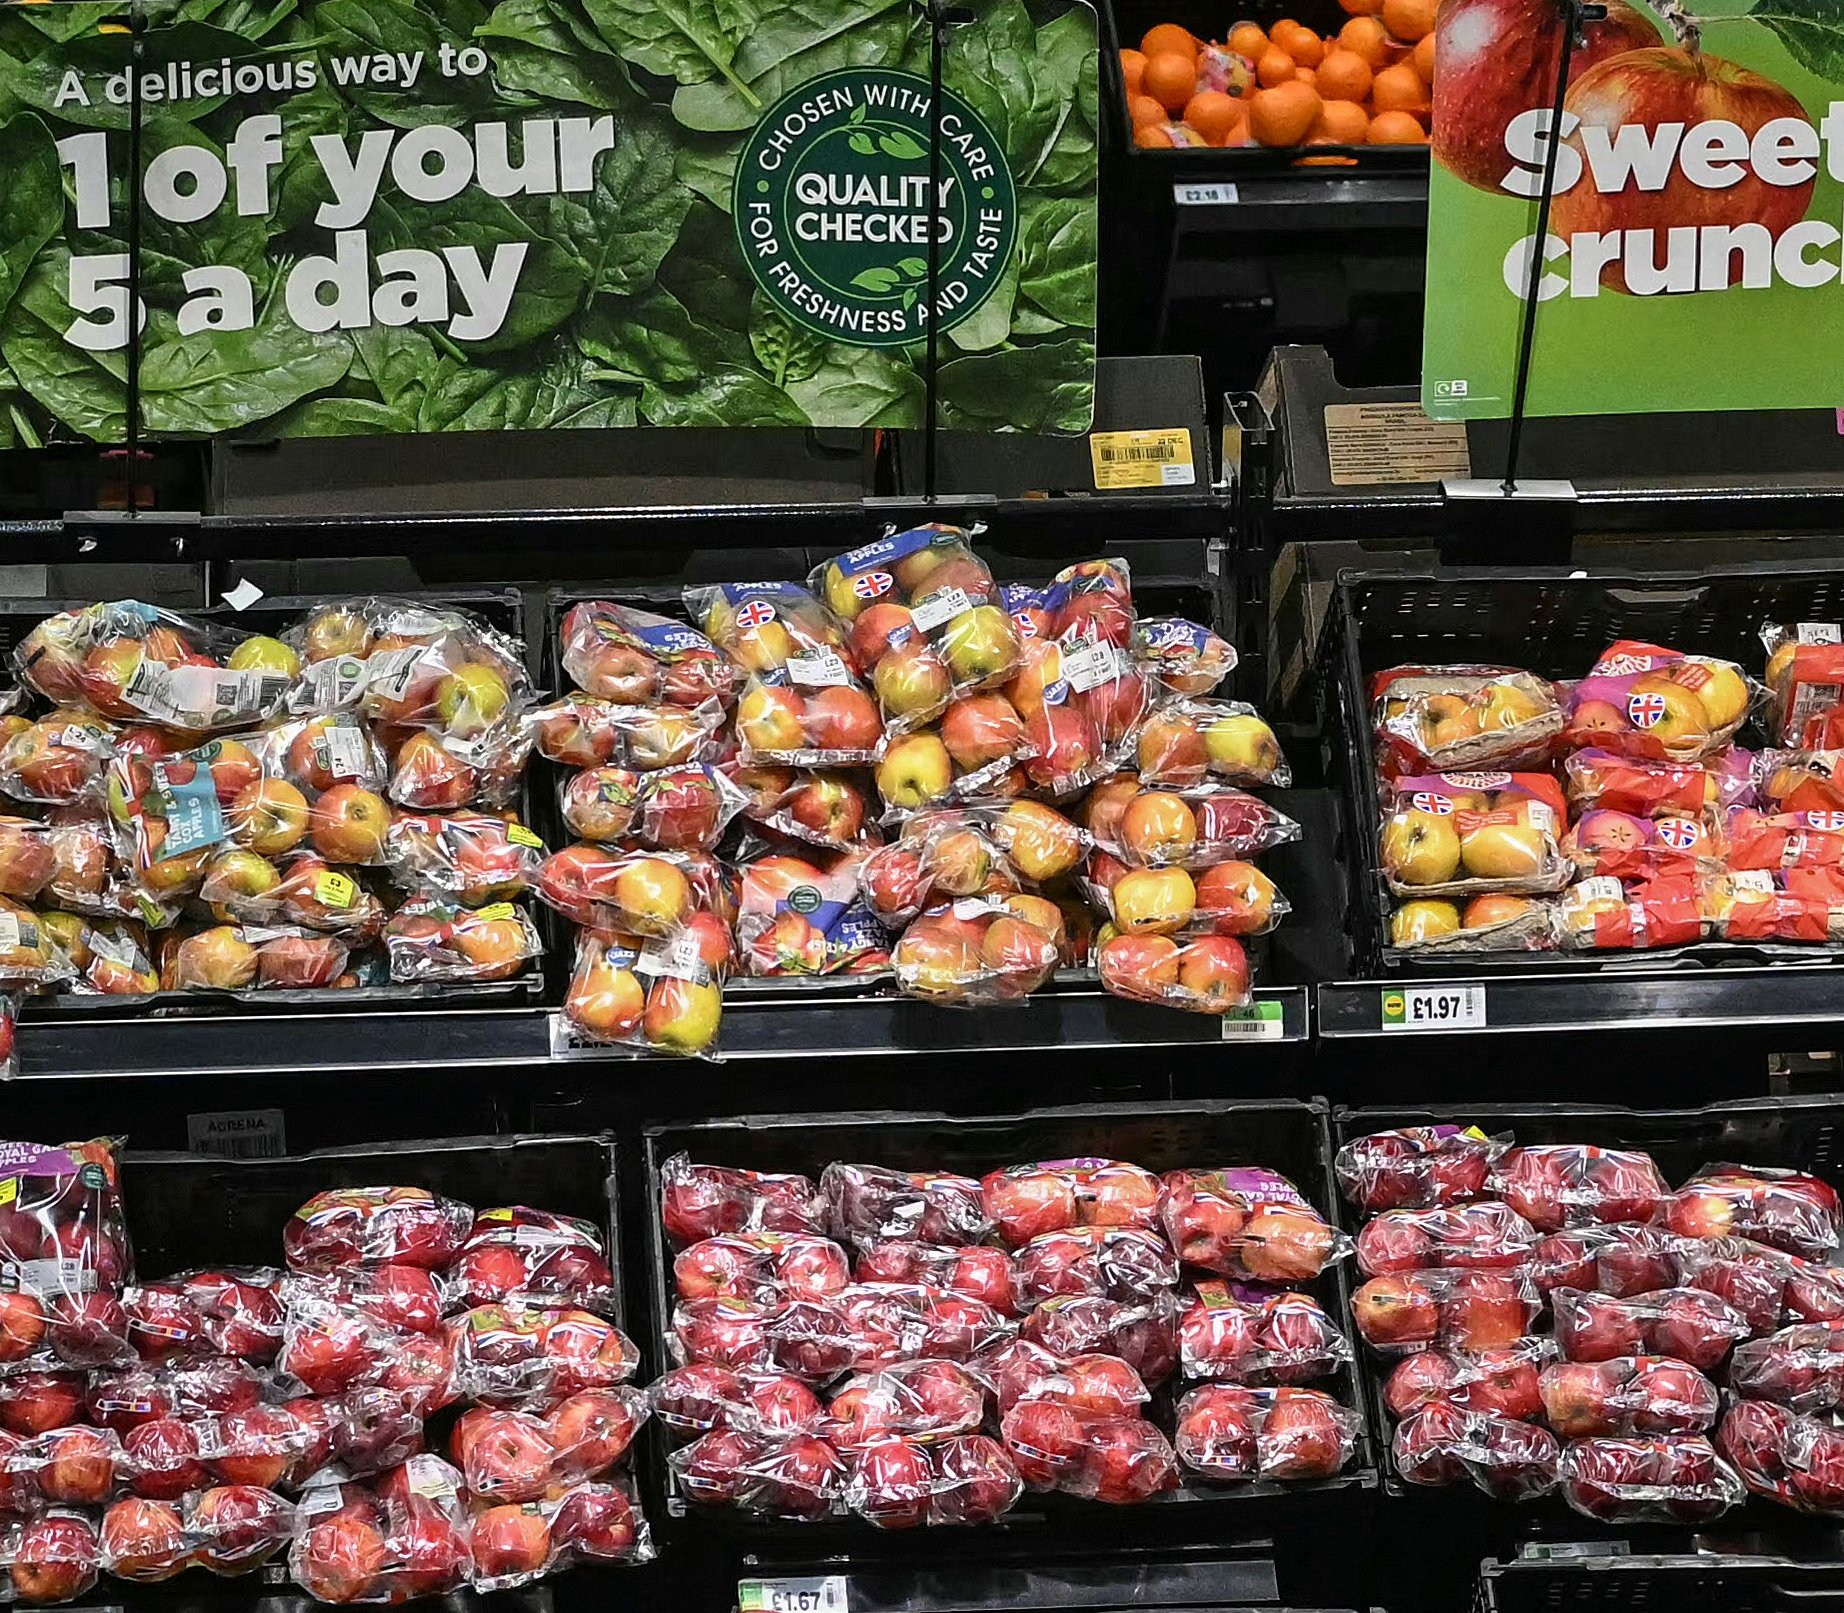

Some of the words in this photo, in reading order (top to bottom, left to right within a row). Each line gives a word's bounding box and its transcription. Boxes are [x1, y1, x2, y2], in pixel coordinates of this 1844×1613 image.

[54, 74, 90, 108] A
[105, 57, 316, 104] delicious
[331, 50, 424, 89] way
[439, 42, 487, 76] to
[759, 87, 854, 171] CHOSEN
[864, 84, 931, 117] WITH
[939, 114, 994, 181] CARE
[56, 131, 111, 229] 1
[143, 115, 282, 223] of
[310, 115, 616, 229] your
[795, 173, 955, 208] QUALITY
[795, 212, 954, 244] CHECKED
[749, 202, 779, 258] FOR
[768, 261, 906, 333] FRESHNESS
[917, 281, 969, 325] AND
[963, 208, 1002, 279] TASTE
[63, 253, 147, 351] 5
[176, 264, 256, 336] a
[285, 229, 529, 341] day
[181, 820, 192, 843] COX
[188, 798, 204, 838] APPLES
[1413, 996, 1460, 1019] £1.97
[772, 1591, 820, 1611] £1.67
